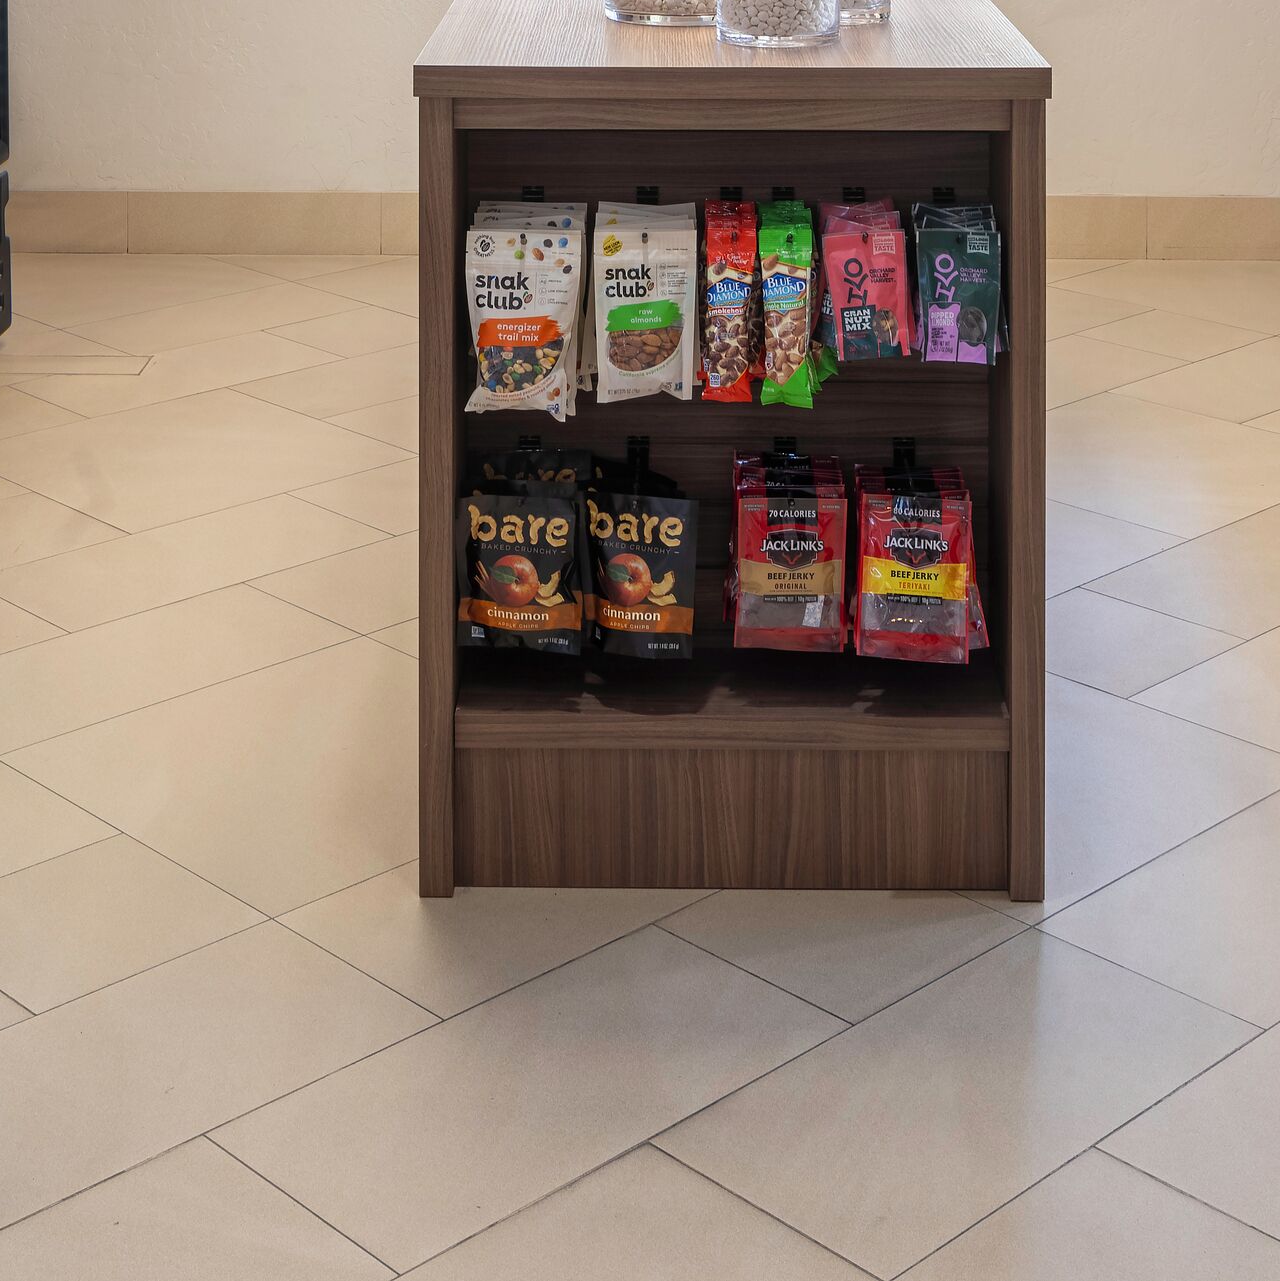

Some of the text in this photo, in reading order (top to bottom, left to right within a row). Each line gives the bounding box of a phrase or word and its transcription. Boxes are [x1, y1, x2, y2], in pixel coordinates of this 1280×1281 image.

[473, 247, 495, 258] GREATNESS
[605, 264, 651, 280] snak
[475, 272, 529, 290] snak
[767, 277, 791, 288] BLUE
[605, 282, 647, 298] club
[716, 282, 740, 293] BLUE
[475, 291, 523, 310] club
[707, 287, 751, 303] DIAMOND
[843, 309, 871, 317] CRAN
[844, 316, 871, 324] NUT
[497, 323, 541, 332] energizer
[846, 323, 872, 332] MIX
[498, 333, 539, 342] trail mix
[779, 510, 816, 518] CALORIES
[904, 508, 940, 518] CALORIES
[468, 504, 569, 547] bare
[587, 499, 683, 547] bare
[760, 540, 790, 551] JACK
[884, 536, 913, 549] JACK
[481, 543, 558, 556] BAKED CRUNCHY
[629, 544, 670, 555] CRUNCHY
[891, 570, 939, 581] BEEF JERKY
[899, 582, 930, 590] TERIYAKI
[487, 606, 549, 621] cinnamon
[603, 605, 660, 621] cinnamon
